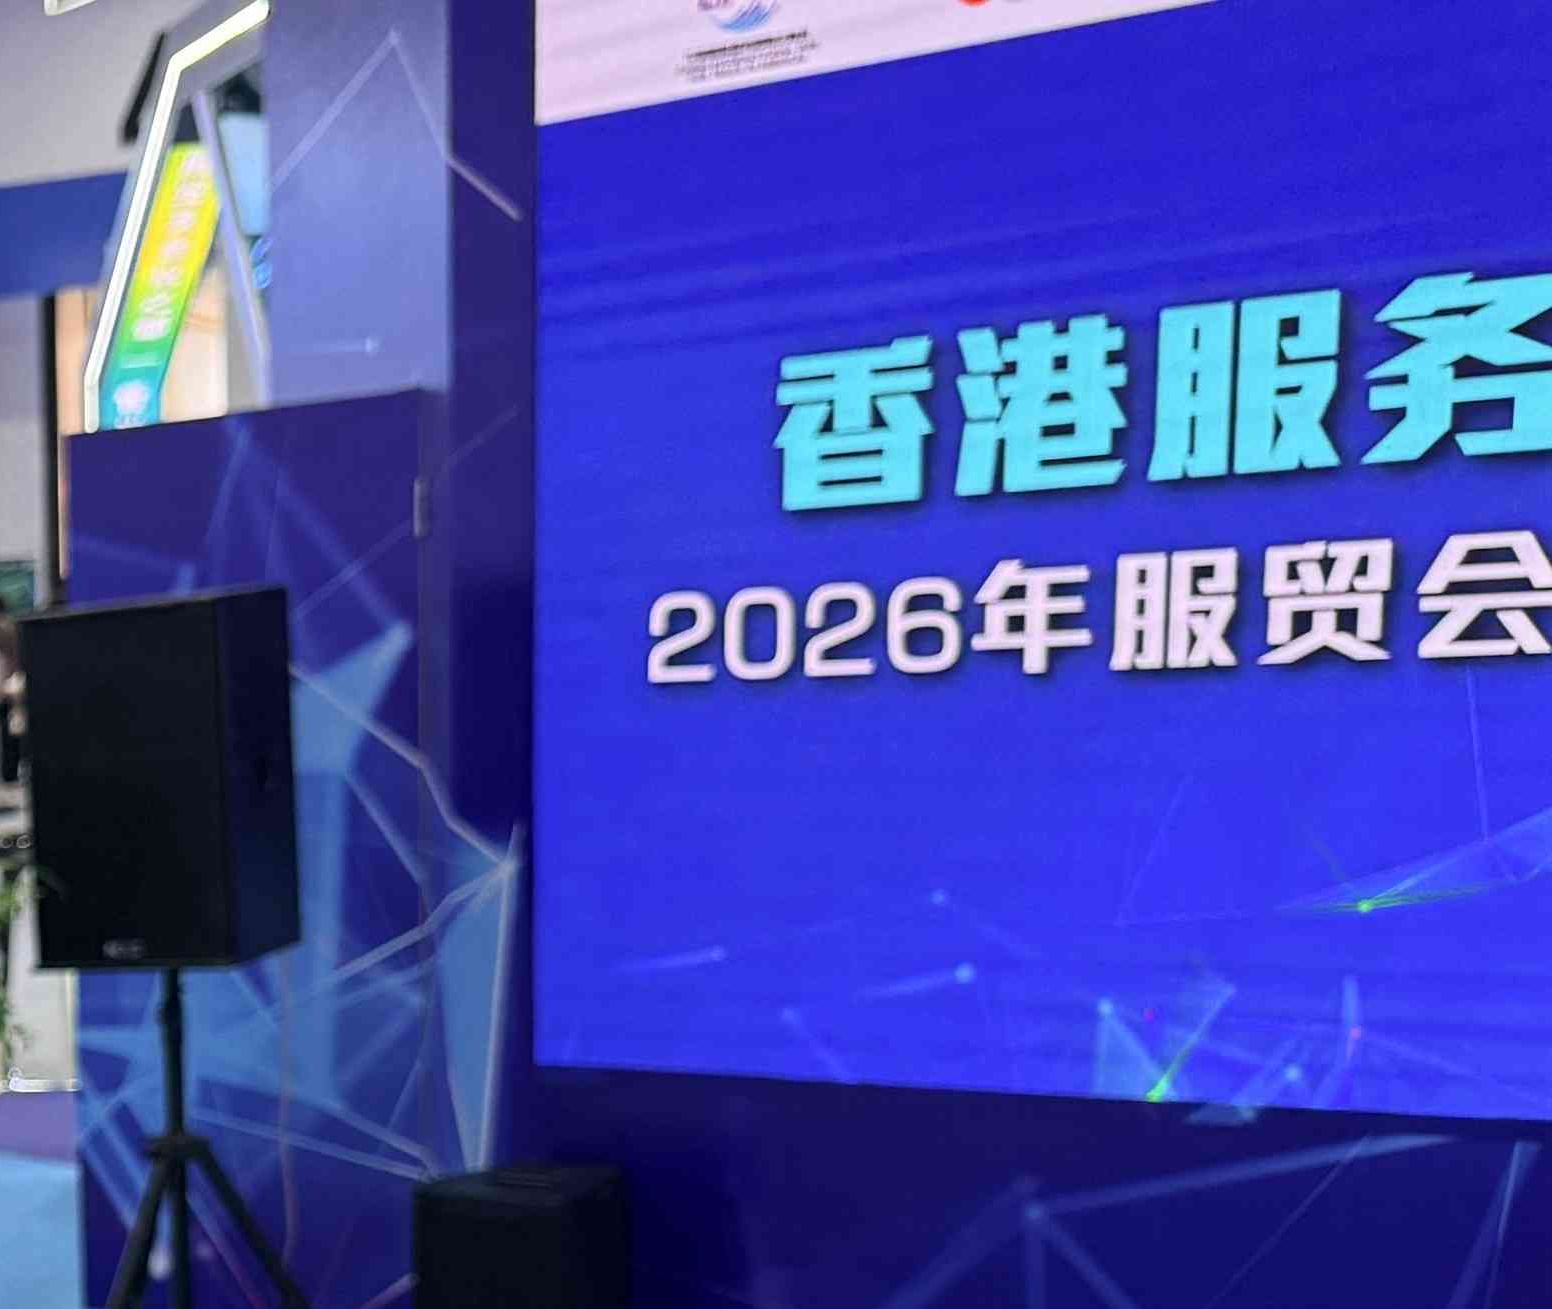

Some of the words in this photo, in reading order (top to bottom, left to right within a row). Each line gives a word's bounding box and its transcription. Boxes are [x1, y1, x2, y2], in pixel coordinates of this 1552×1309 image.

[773, 271, 1552, 512] 香港服务
[647, 529, 1552, 686] 2026年服贸会
